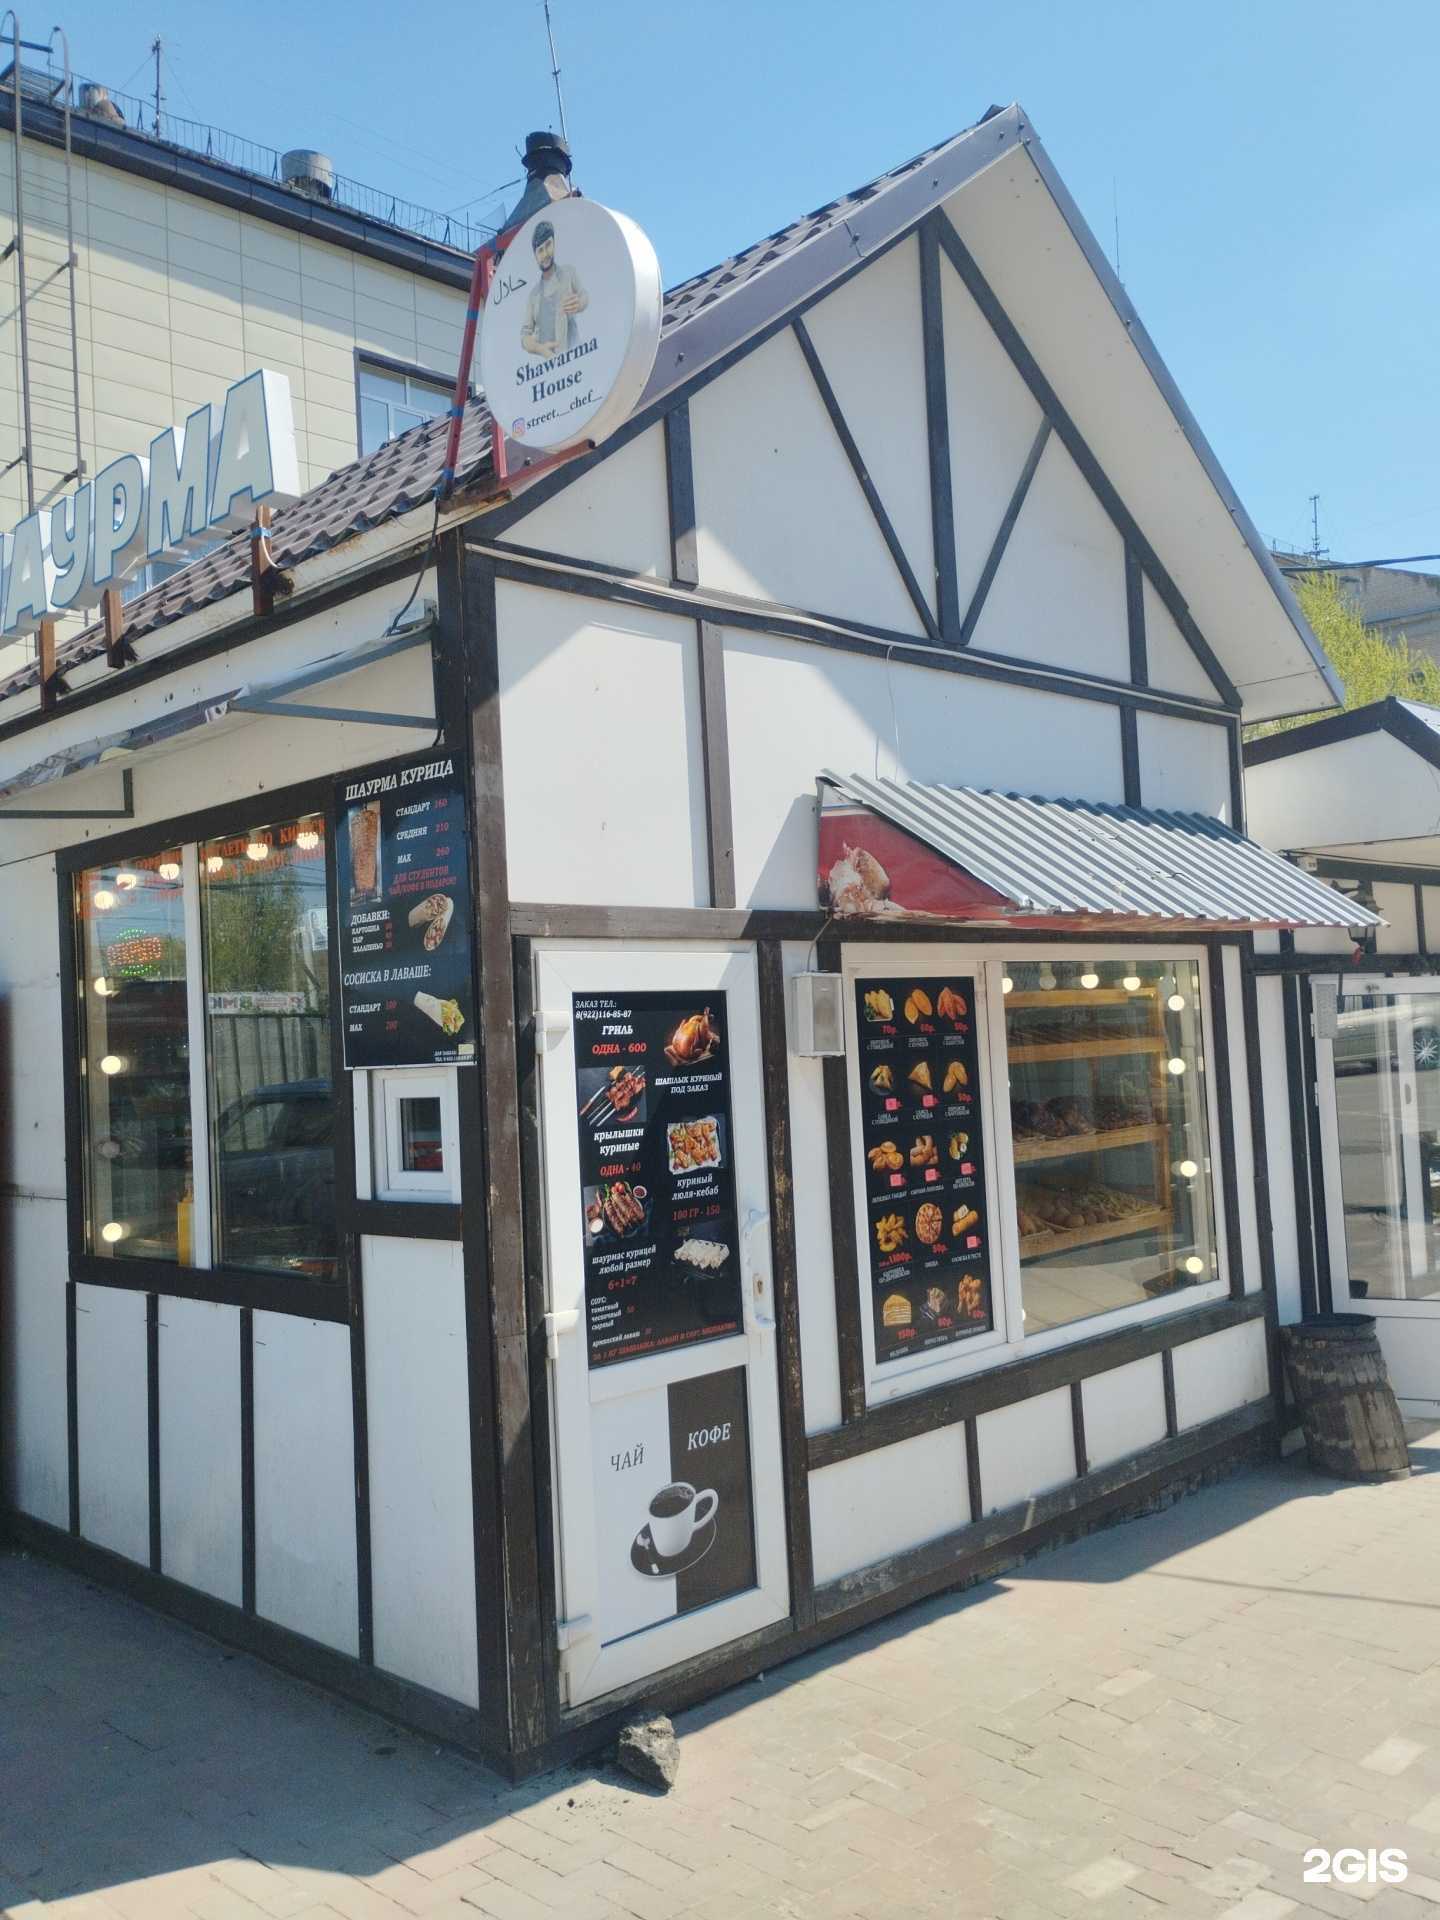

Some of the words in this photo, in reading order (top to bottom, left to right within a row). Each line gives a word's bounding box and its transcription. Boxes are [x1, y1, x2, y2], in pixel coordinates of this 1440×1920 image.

[516, 337, 599, 387] Shawarma
[532, 369, 583, 404] House
[0, 368, 285, 640] АУРМА
[345, 773, 397, 800] ШАУРМА
[400, 759, 453, 786] КУРИЦА
[396, 802, 430, 816] СТАНДАРТ
[351, 910, 389, 926] ДОБАВКИ:
[344, 970, 381, 985] СОСИСКА
[383, 970, 389, 981] В
[390, 964, 432, 980] ЛАВАШЕ:
[349, 1003, 380, 1014] СТАНДАРТ
[575, 1000, 598, 1008] ЗАКАЗ
[602, 1025, 633, 1035] ГРИЛЬ
[592, 1043, 620, 1054] ОДНА
[628, 1043, 646, 1052] 600
[655, 1075, 688, 1085] ШАШЛЫК
[690, 1072, 722, 1082] КУРИНЫЙ
[671, 1086, 685, 1094] ПОД
[687, 1084, 708, 1092] ЗАКАЗ
[594, 1128, 643, 1143] крылышки
[600, 1142, 639, 1156] куриные
[600, 1166, 624, 1176] ОДНА
[677, 1173, 712, 1187] куриный
[672, 1186, 718, 1201] люля-кебаб
[672, 1210, 686, 1221] 100
[626, 1244, 656, 1260] курицей
[598, 1262, 623, 1274] любой
[625, 1258, 650, 1272] размер
[687, 1422, 730, 1450] КОФЕ
[611, 1443, 644, 1471] ЧАЙ
